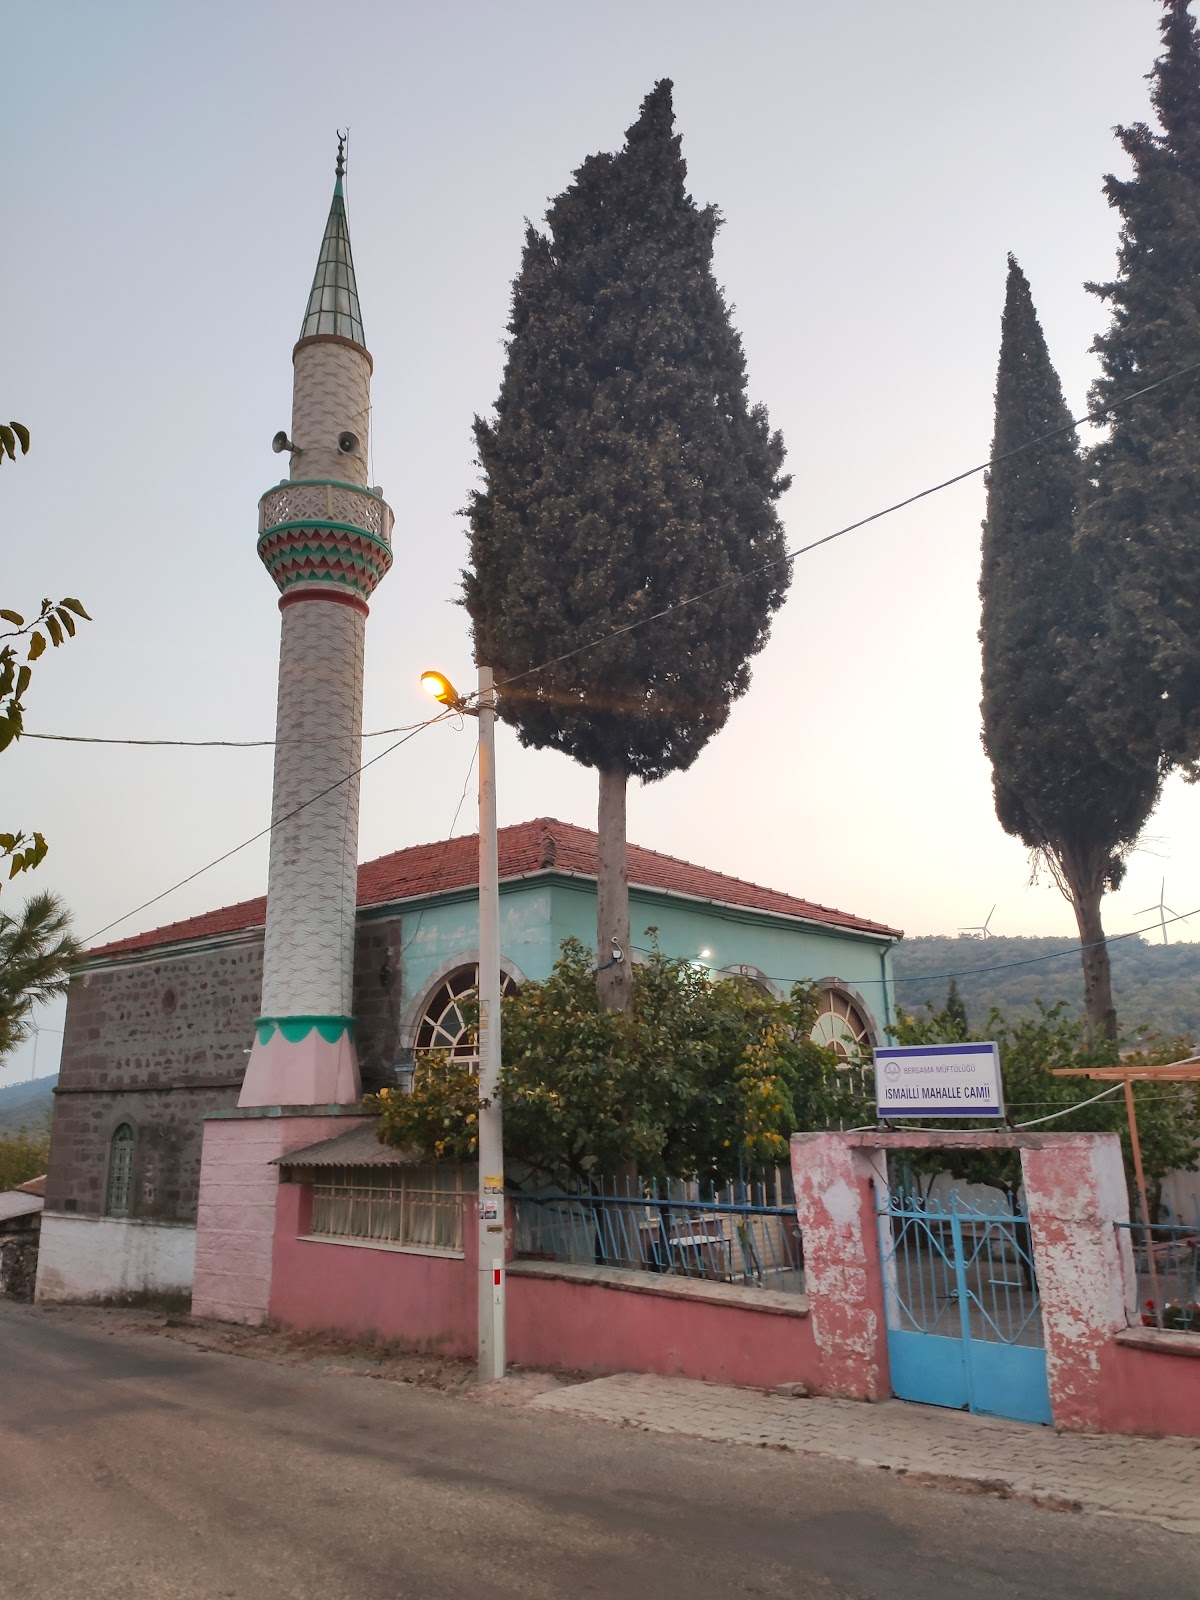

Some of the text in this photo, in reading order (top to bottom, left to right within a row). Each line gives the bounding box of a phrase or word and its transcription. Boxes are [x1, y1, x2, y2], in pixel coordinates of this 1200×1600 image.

[904, 1064, 976, 1074] BERGAMA MÜFTÜLÜĞÜ
[885, 1083, 991, 1099] İSMAİLLİ MAHALLE CAMİİ
